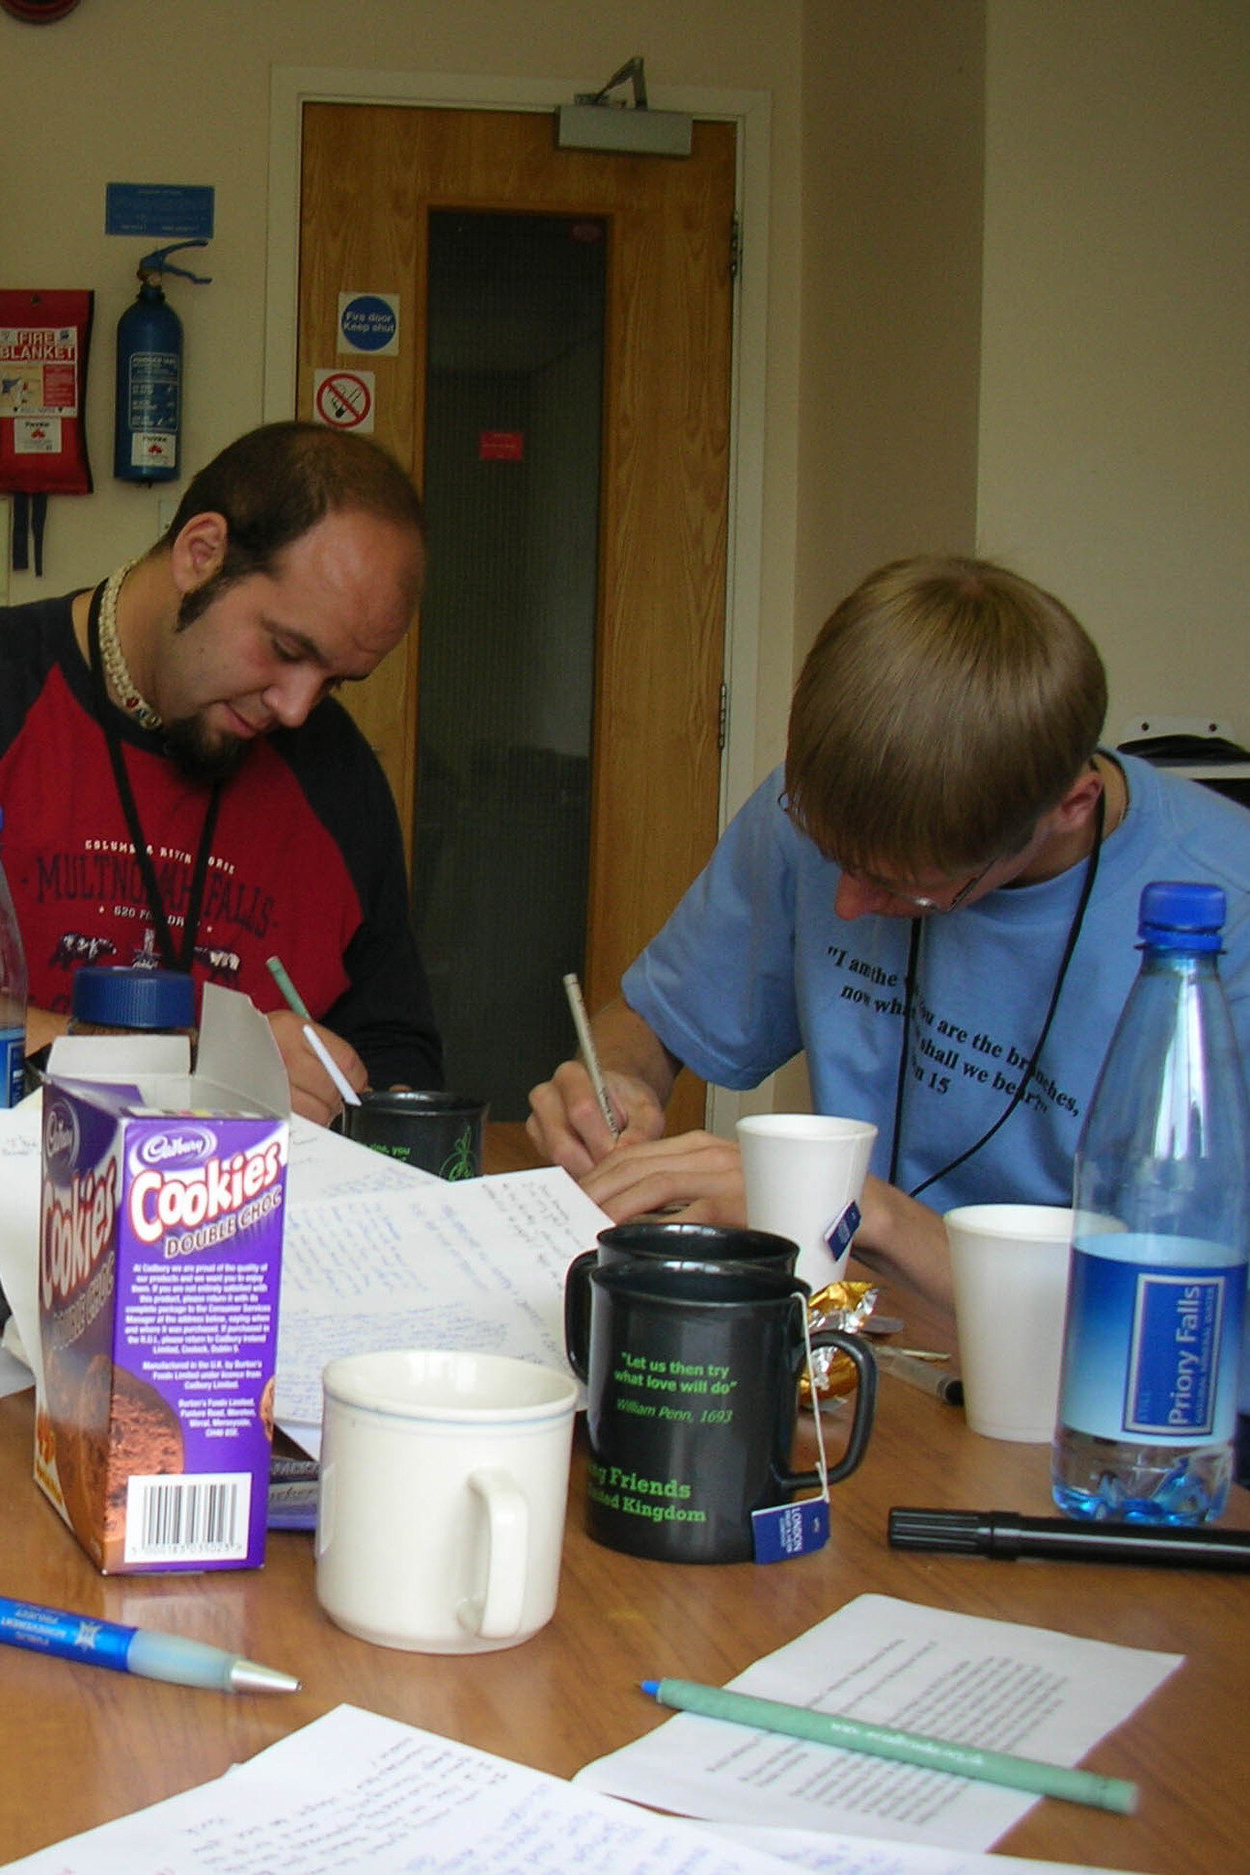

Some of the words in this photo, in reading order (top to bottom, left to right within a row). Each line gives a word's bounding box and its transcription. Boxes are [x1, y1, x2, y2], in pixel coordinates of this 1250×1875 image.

[343, 323, 369, 335] Keep
[371, 324, 395, 333] shut
[345, 311, 364, 322] Fire
[17, 331, 55, 344] FIRE
[85, 840, 154, 855] COLUMBA
[937, 1020, 967, 1043] are
[972, 1033, 1002, 1058] the
[920, 1038, 959, 1070] shall
[963, 1061, 989, 1083] we
[928, 1076, 952, 1096] 15
[141, 1134, 206, 1163] Cadbury
[129, 1142, 281, 1246] Cookies
[165, 1214, 237, 1258] DOUBLE
[238, 1184, 282, 1229] CHOC
[1175, 1285, 1200, 1343] Falls
[613, 1370, 644, 1386] what
[646, 1375, 677, 1392] love
[680, 1379, 708, 1395] will
[650, 1361, 667, 1373] us
[670, 1360, 704, 1376] then
[707, 1365, 730, 1379] try
[1168, 1350, 1199, 1426] Priory
[616, 1398, 657, 1418] William
[699, 1409, 734, 1424] 1693
[609, 1466, 692, 1499] Friends
[622, 1497, 707, 1524] Kingdom
[791, 1507, 804, 1551] LONDON
